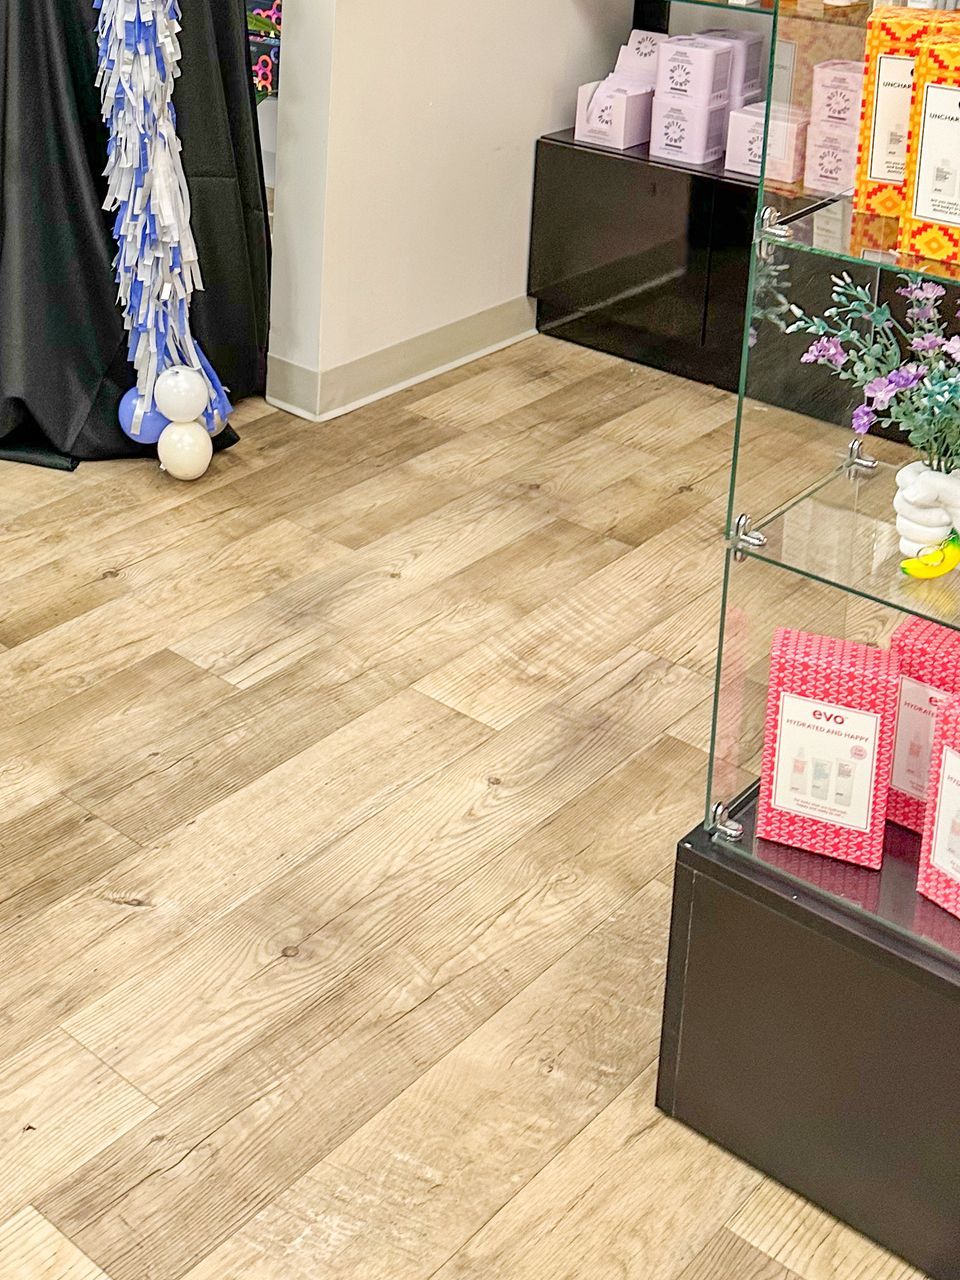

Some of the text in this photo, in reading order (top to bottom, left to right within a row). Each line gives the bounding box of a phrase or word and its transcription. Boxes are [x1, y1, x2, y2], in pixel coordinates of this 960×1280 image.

[812, 709, 845, 725] evo
[903, 701, 939, 718] HYDRATE
[786, 718, 870, 744] HYDRATED AND HAPPY
